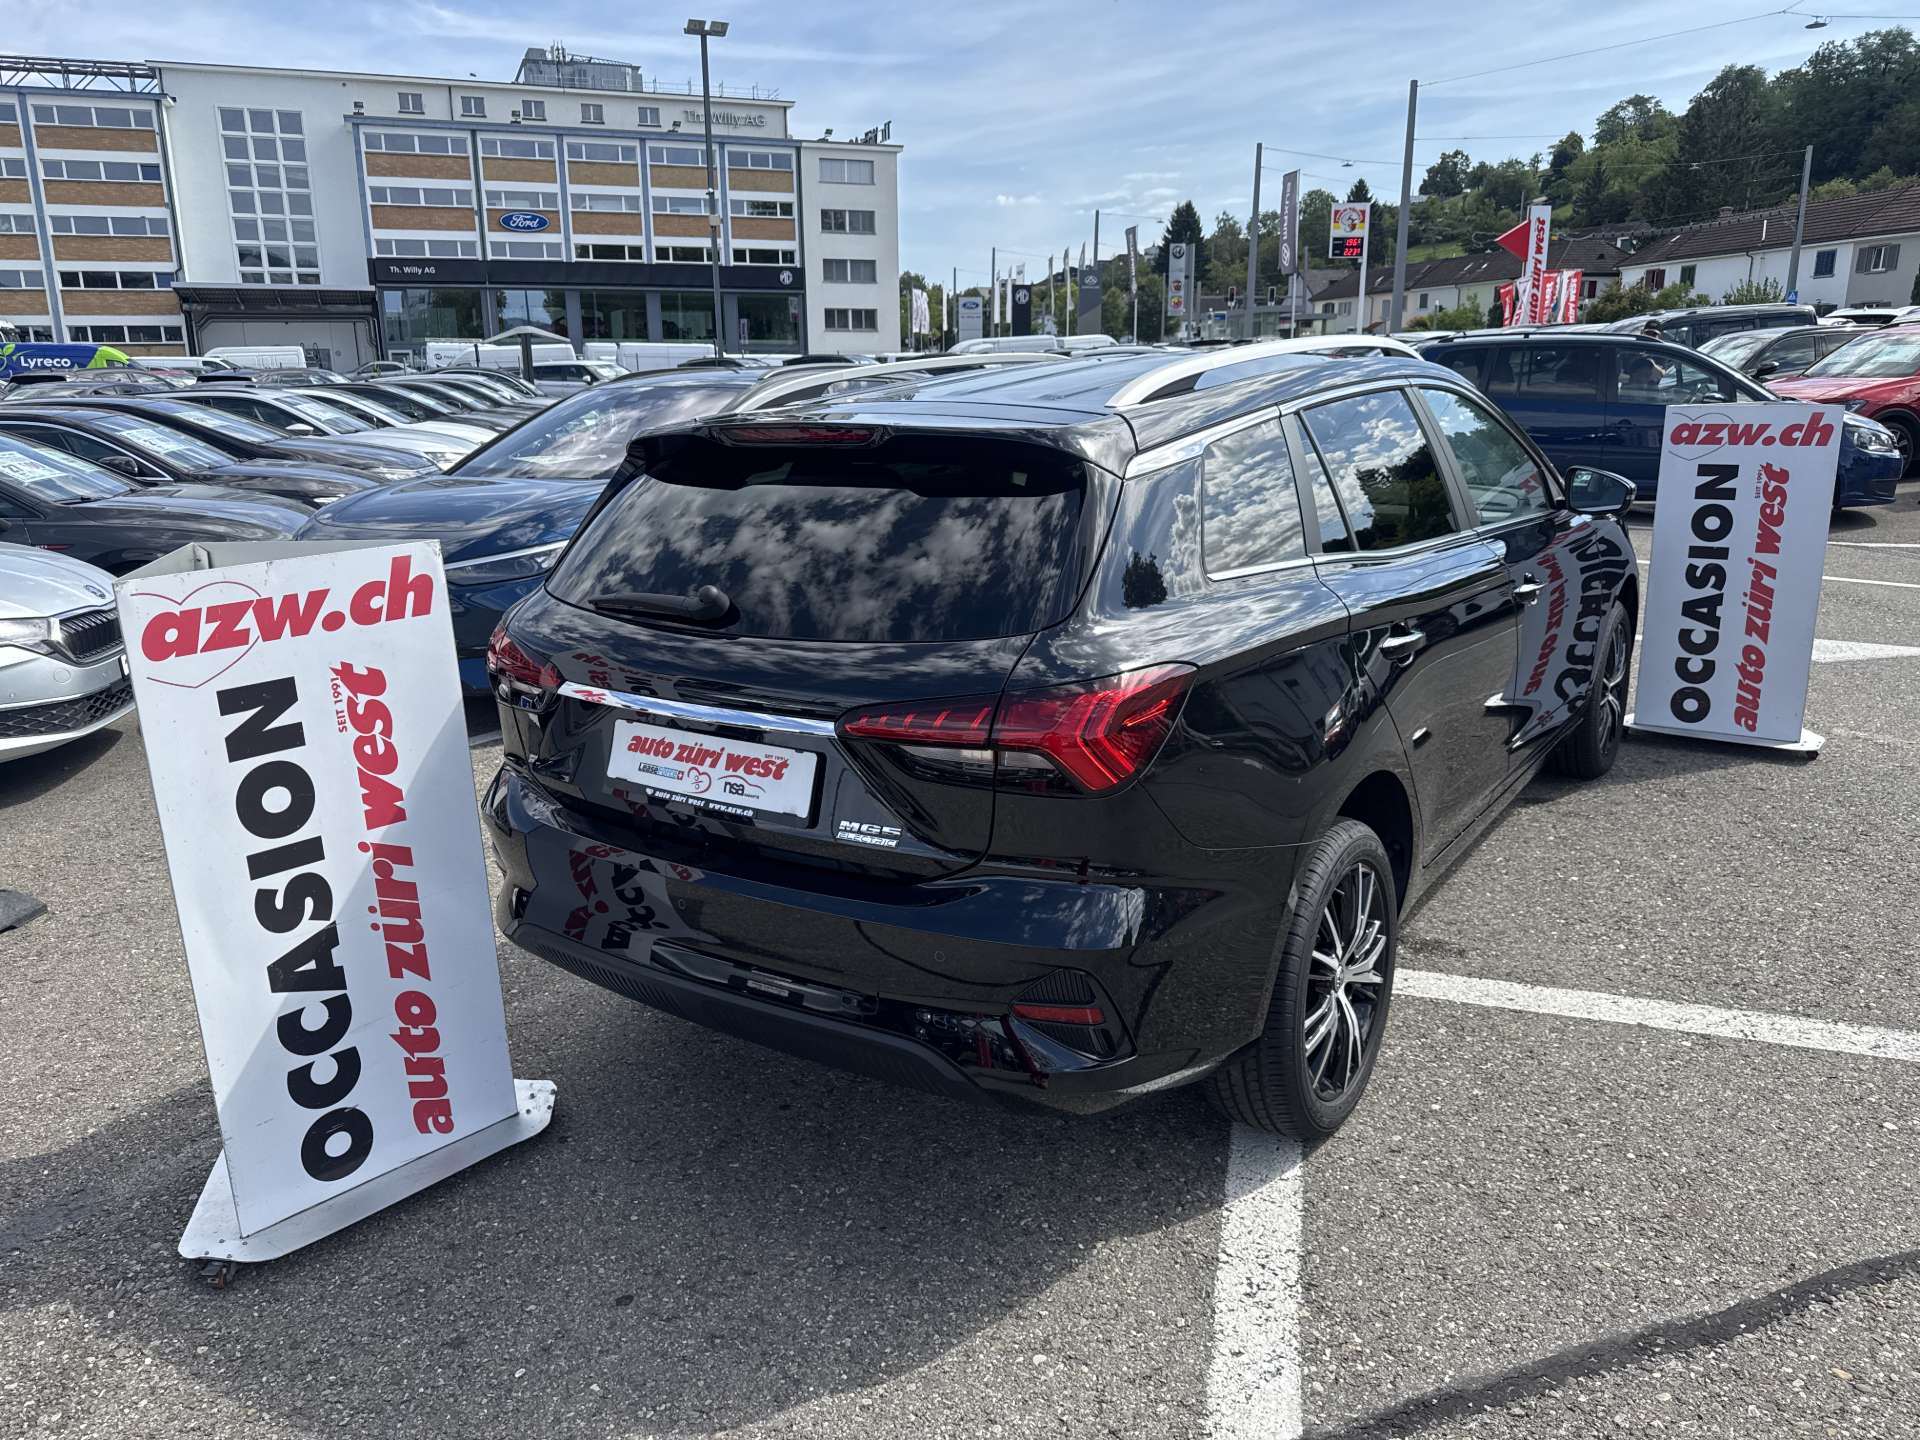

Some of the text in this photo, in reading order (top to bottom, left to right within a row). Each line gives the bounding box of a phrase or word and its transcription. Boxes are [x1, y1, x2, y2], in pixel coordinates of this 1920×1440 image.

[745, 114, 766, 128] AG
[507, 213, 542, 229] Ford
[403, 266, 422, 275] Willy
[1015, 289, 1030, 304] MG
[20, 356, 71, 368] Lyreco
[1670, 412, 1835, 447] azw.ch
[1670, 463, 1740, 724] OCCASION
[1734, 462, 1790, 732] auto züri west
[141, 555, 434, 662] azw.ch
[331, 676, 348, 733] SEIT 1991
[627, 735, 789, 781] auto züri west
[654, 790, 670, 800] auto
[688, 797, 706, 807] west
[723, 781, 745, 796] nsa
[838, 820, 902, 835] MG5
[329, 661, 455, 1135] auto züri west
[216, 676, 374, 1182] OCCASION
